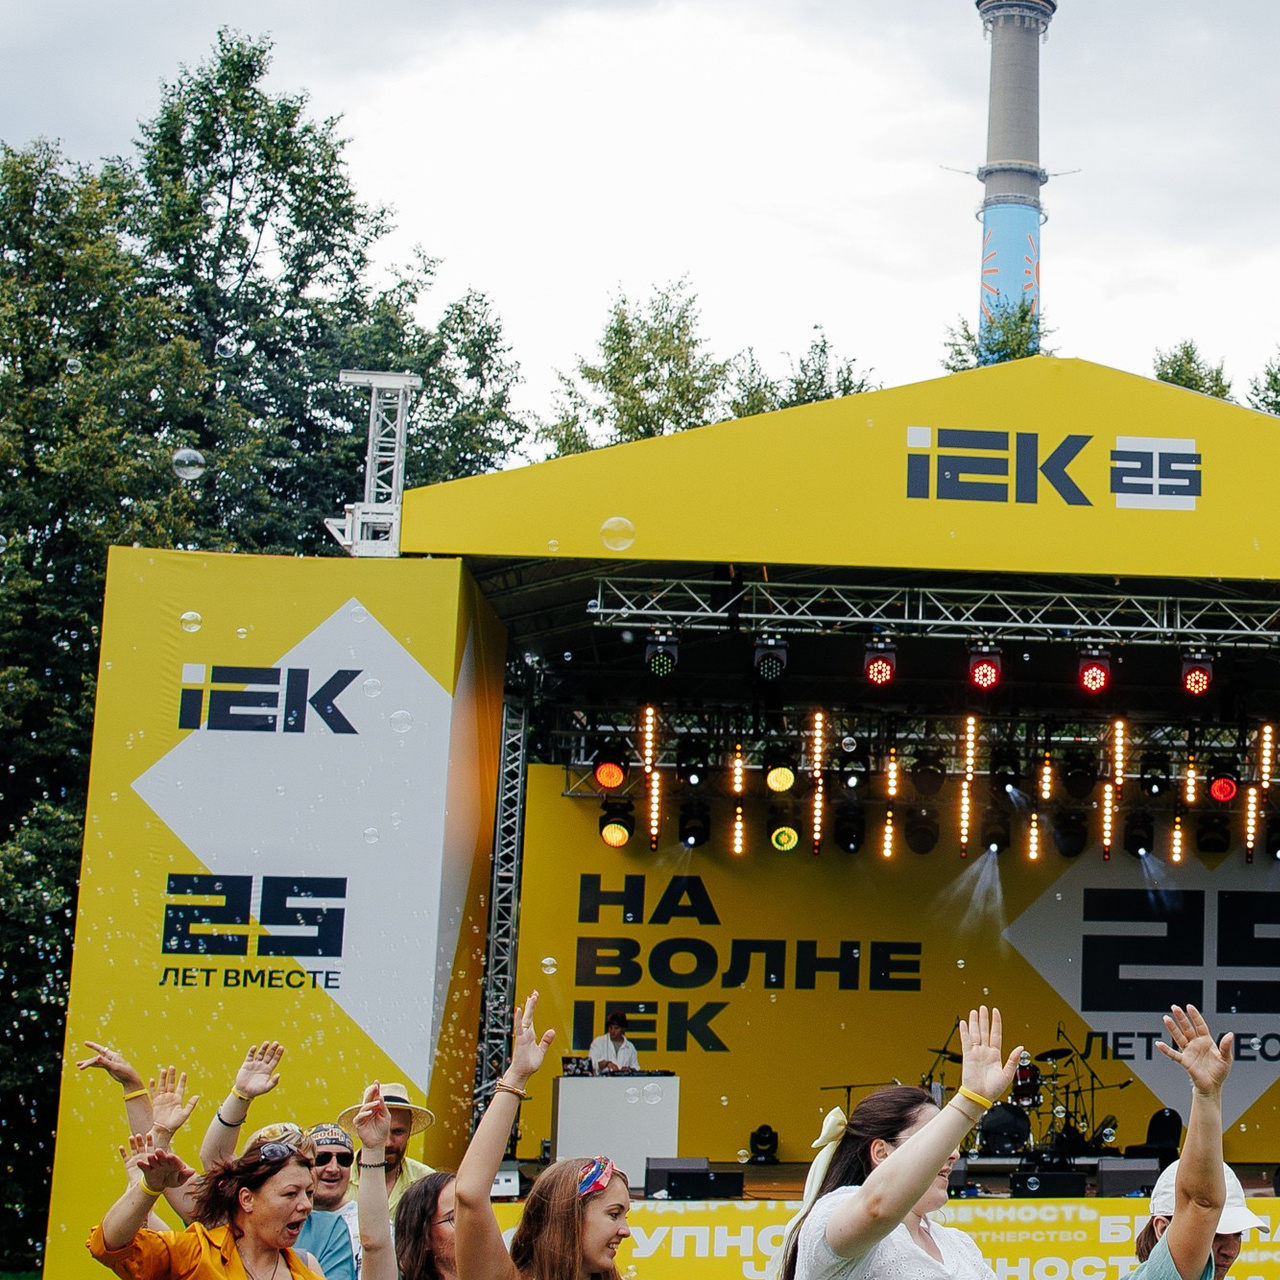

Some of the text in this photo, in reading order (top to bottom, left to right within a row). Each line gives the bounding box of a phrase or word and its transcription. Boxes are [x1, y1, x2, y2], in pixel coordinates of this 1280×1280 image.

[1110, 450, 1202, 496] 25
[161, 873, 347, 957] 25
[578, 874, 721, 925] НА
[159, 967, 342, 989] ЛЕТ ВМЕСТЕ
[574, 936, 922, 992] ВОЛНЕ
[1081, 1031, 1162, 1061] ЛЕТ
